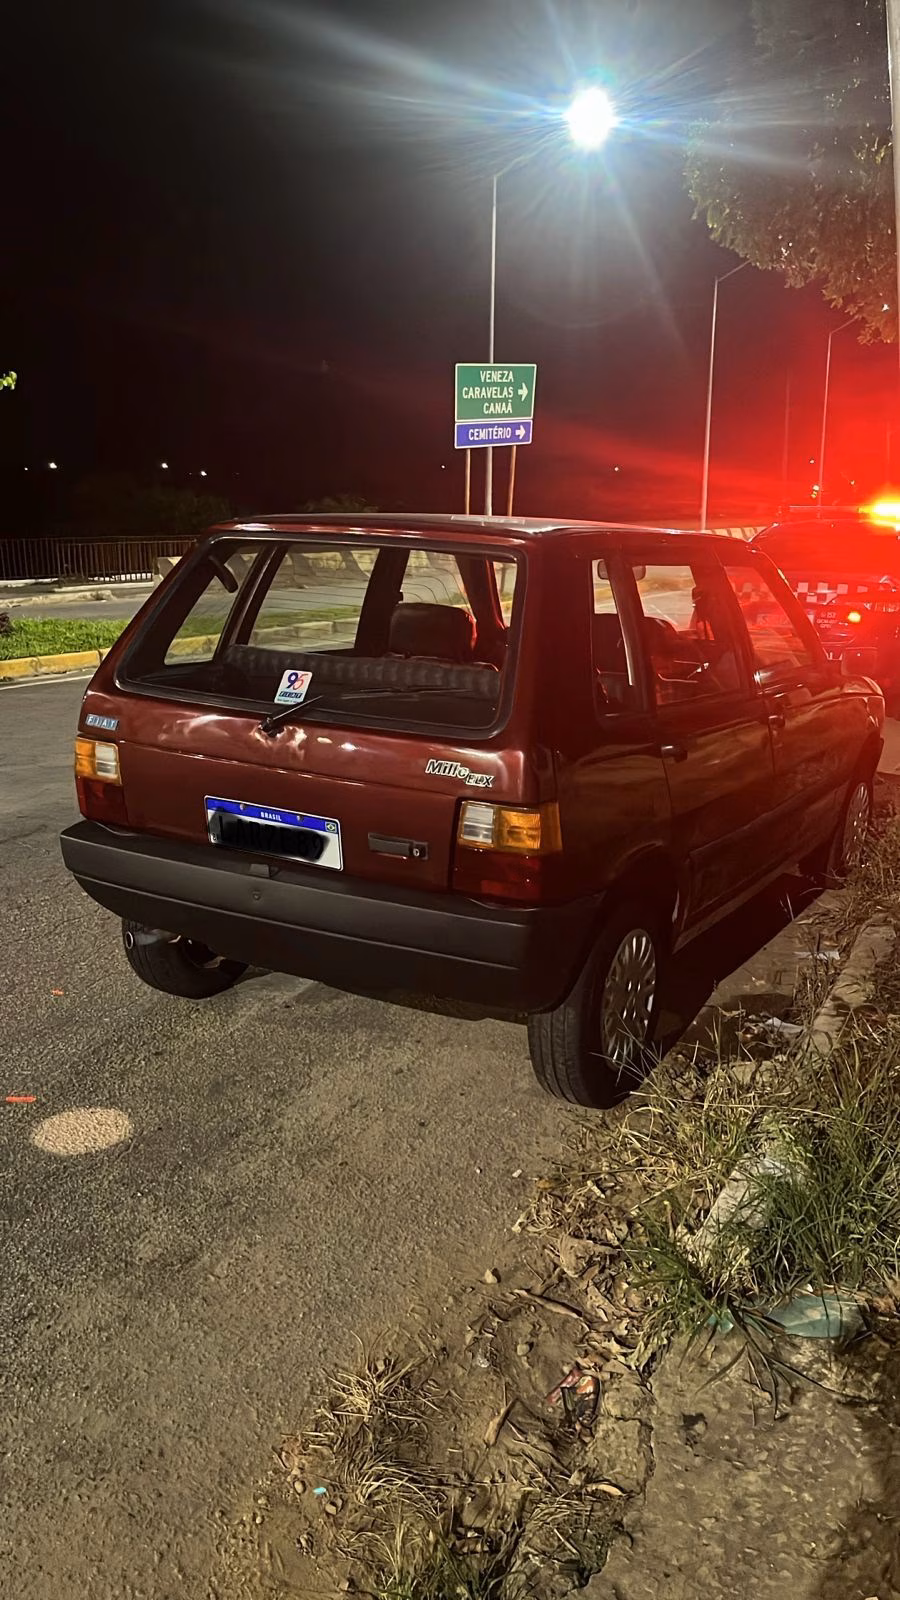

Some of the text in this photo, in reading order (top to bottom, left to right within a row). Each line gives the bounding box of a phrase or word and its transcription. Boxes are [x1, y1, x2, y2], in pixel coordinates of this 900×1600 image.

[480, 371, 514, 383] VENEZA
[462, 386, 514, 399] CARAVELAS
[483, 400, 513, 414] CANAÃ
[468, 425, 512, 441] CEMITÉRIO
[287, 672, 308, 691] 95
[87, 714, 118, 730] FIAT
[465, 773, 494, 787] ELX
[260, 811, 283, 822] BRASIL
